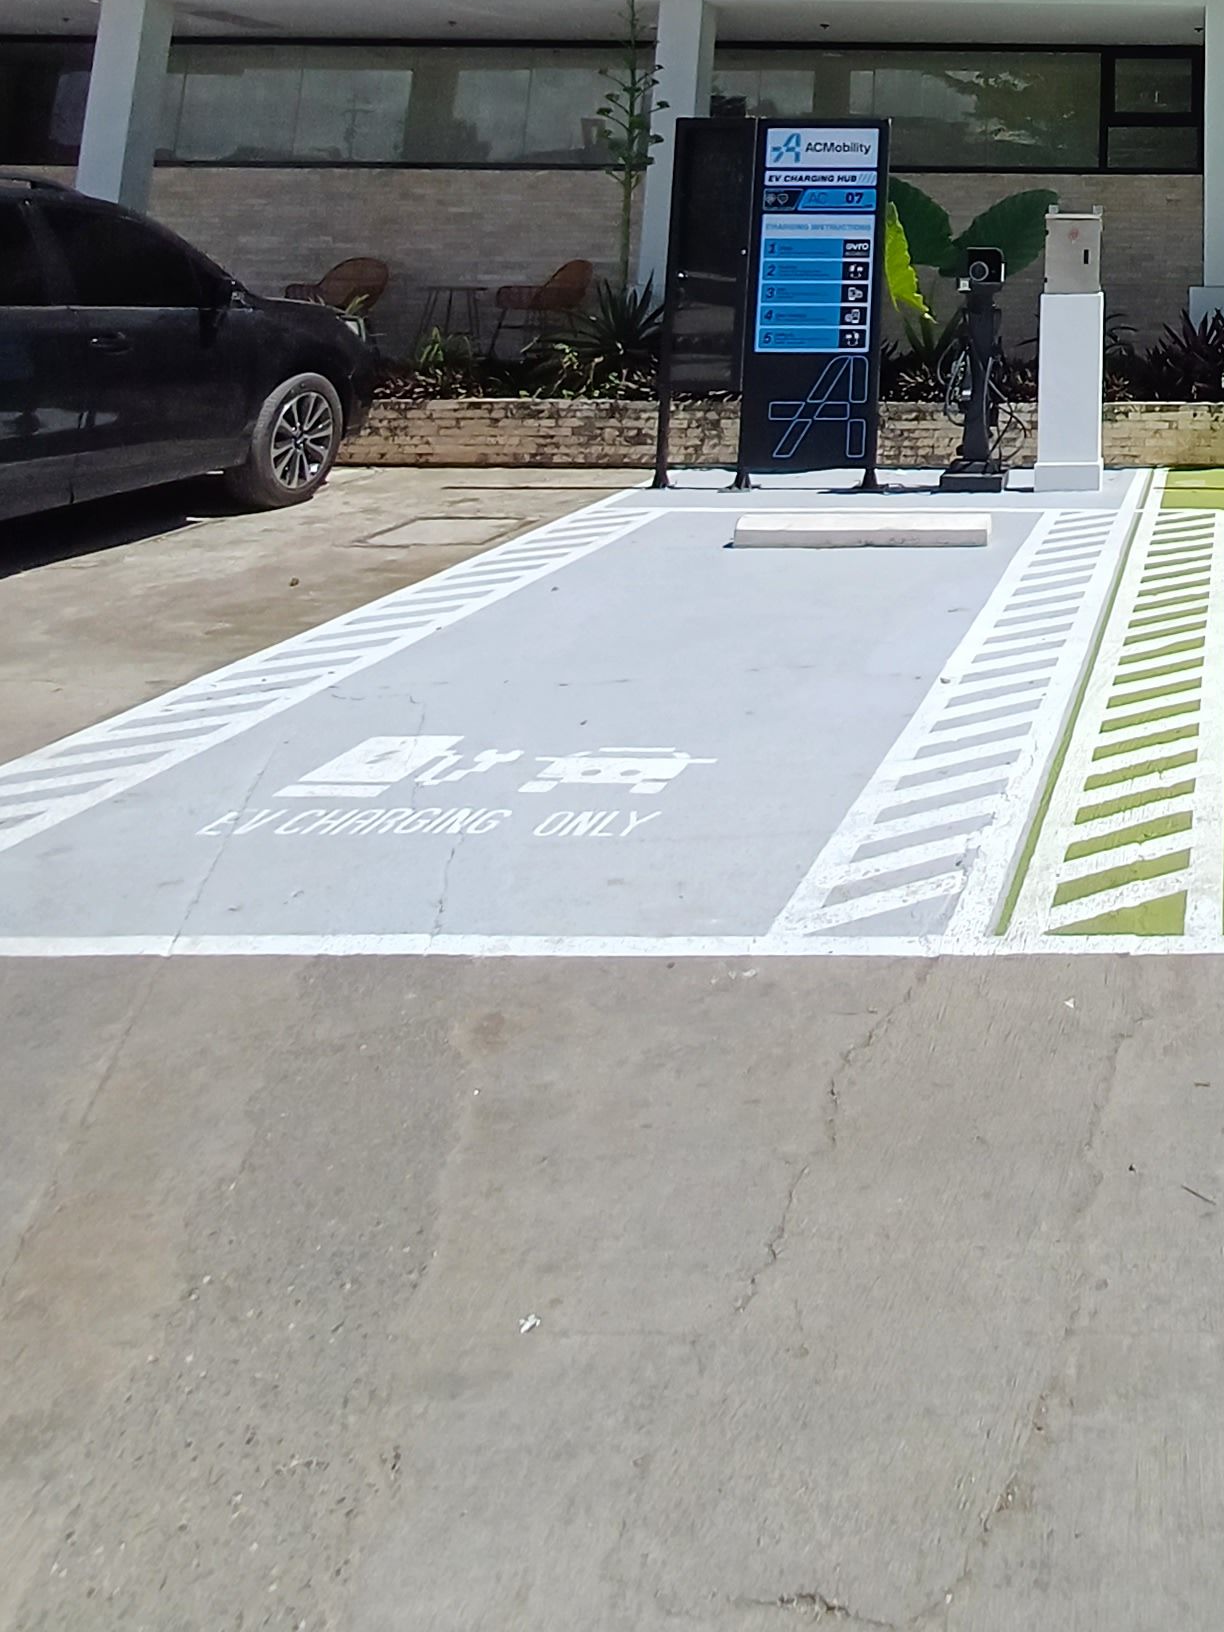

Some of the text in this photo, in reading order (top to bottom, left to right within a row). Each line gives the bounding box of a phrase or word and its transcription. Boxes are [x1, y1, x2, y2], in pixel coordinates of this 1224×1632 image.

[805, 142, 871, 155] ACMobility
[845, 192, 864, 204] 07
[768, 243, 776, 254] 1
[767, 264, 776, 276] 2
[765, 287, 775, 298] 3
[764, 310, 773, 320] 4
[763, 332, 772, 344] 5
[195, 809, 662, 837] EV CHARGING ONLY
